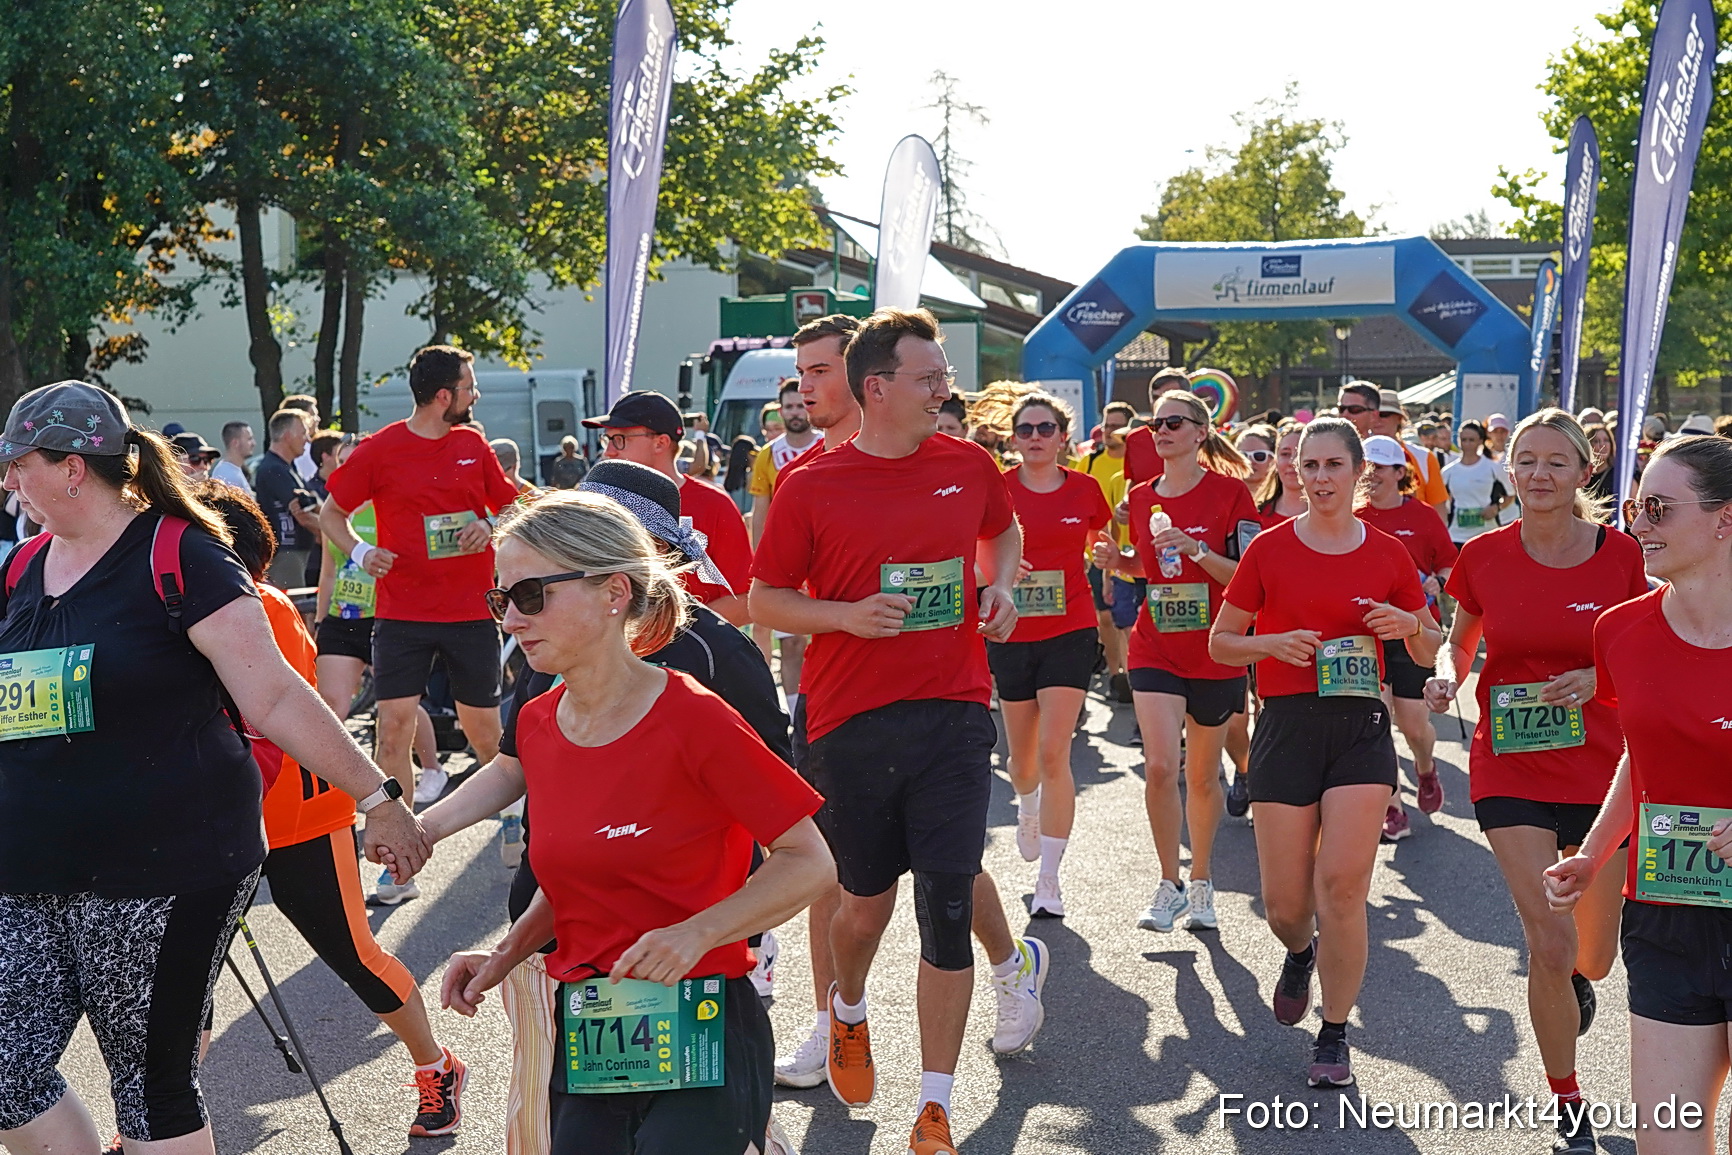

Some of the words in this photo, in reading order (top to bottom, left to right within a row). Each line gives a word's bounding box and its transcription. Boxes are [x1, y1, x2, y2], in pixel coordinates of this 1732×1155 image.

[629, 13, 659, 153] Fischer
[1661, 12, 1700, 158] Fischer
[1677, 36, 1705, 152] AUTOMOBILE
[1573, 141, 1591, 244] Fischer
[1246, 276, 1336, 297] firmenlauf
[1076, 308, 1125, 320] Fischer
[342, 580, 363, 595] 593
[1015, 586, 1054, 603] 1731
[954, 584, 962, 616] 2022
[1156, 600, 1199, 617] 1685
[1575, 601, 1595, 612] DEHN
[928, 608, 951, 617] Simon
[1321, 664, 1331, 685] RUN
[1331, 655, 1378, 678] 1684
[1331, 677, 1359, 685] Nicklas
[0, 680, 36, 713] 291
[48, 682, 60, 722] 2022
[18, 711, 48, 722] Esther
[1495, 716, 1505, 740] RUN
[1504, 705, 1568, 731] 1720
[1514, 730, 1542, 740] Pfister
[1544, 729, 1560, 738] Ute
[606, 822, 638, 840] DEHN
[1645, 848, 1657, 882] RUN
[1661, 838, 1732, 875] 170
[1656, 872, 1722, 887] Ochsenkühn
[578, 1014, 655, 1056] 1714
[657, 1019, 673, 1073] 2022
[568, 1031, 579, 1071] RUN
[582, 1058, 604, 1072] Jahn
[605, 1057, 650, 1072] Corinna
